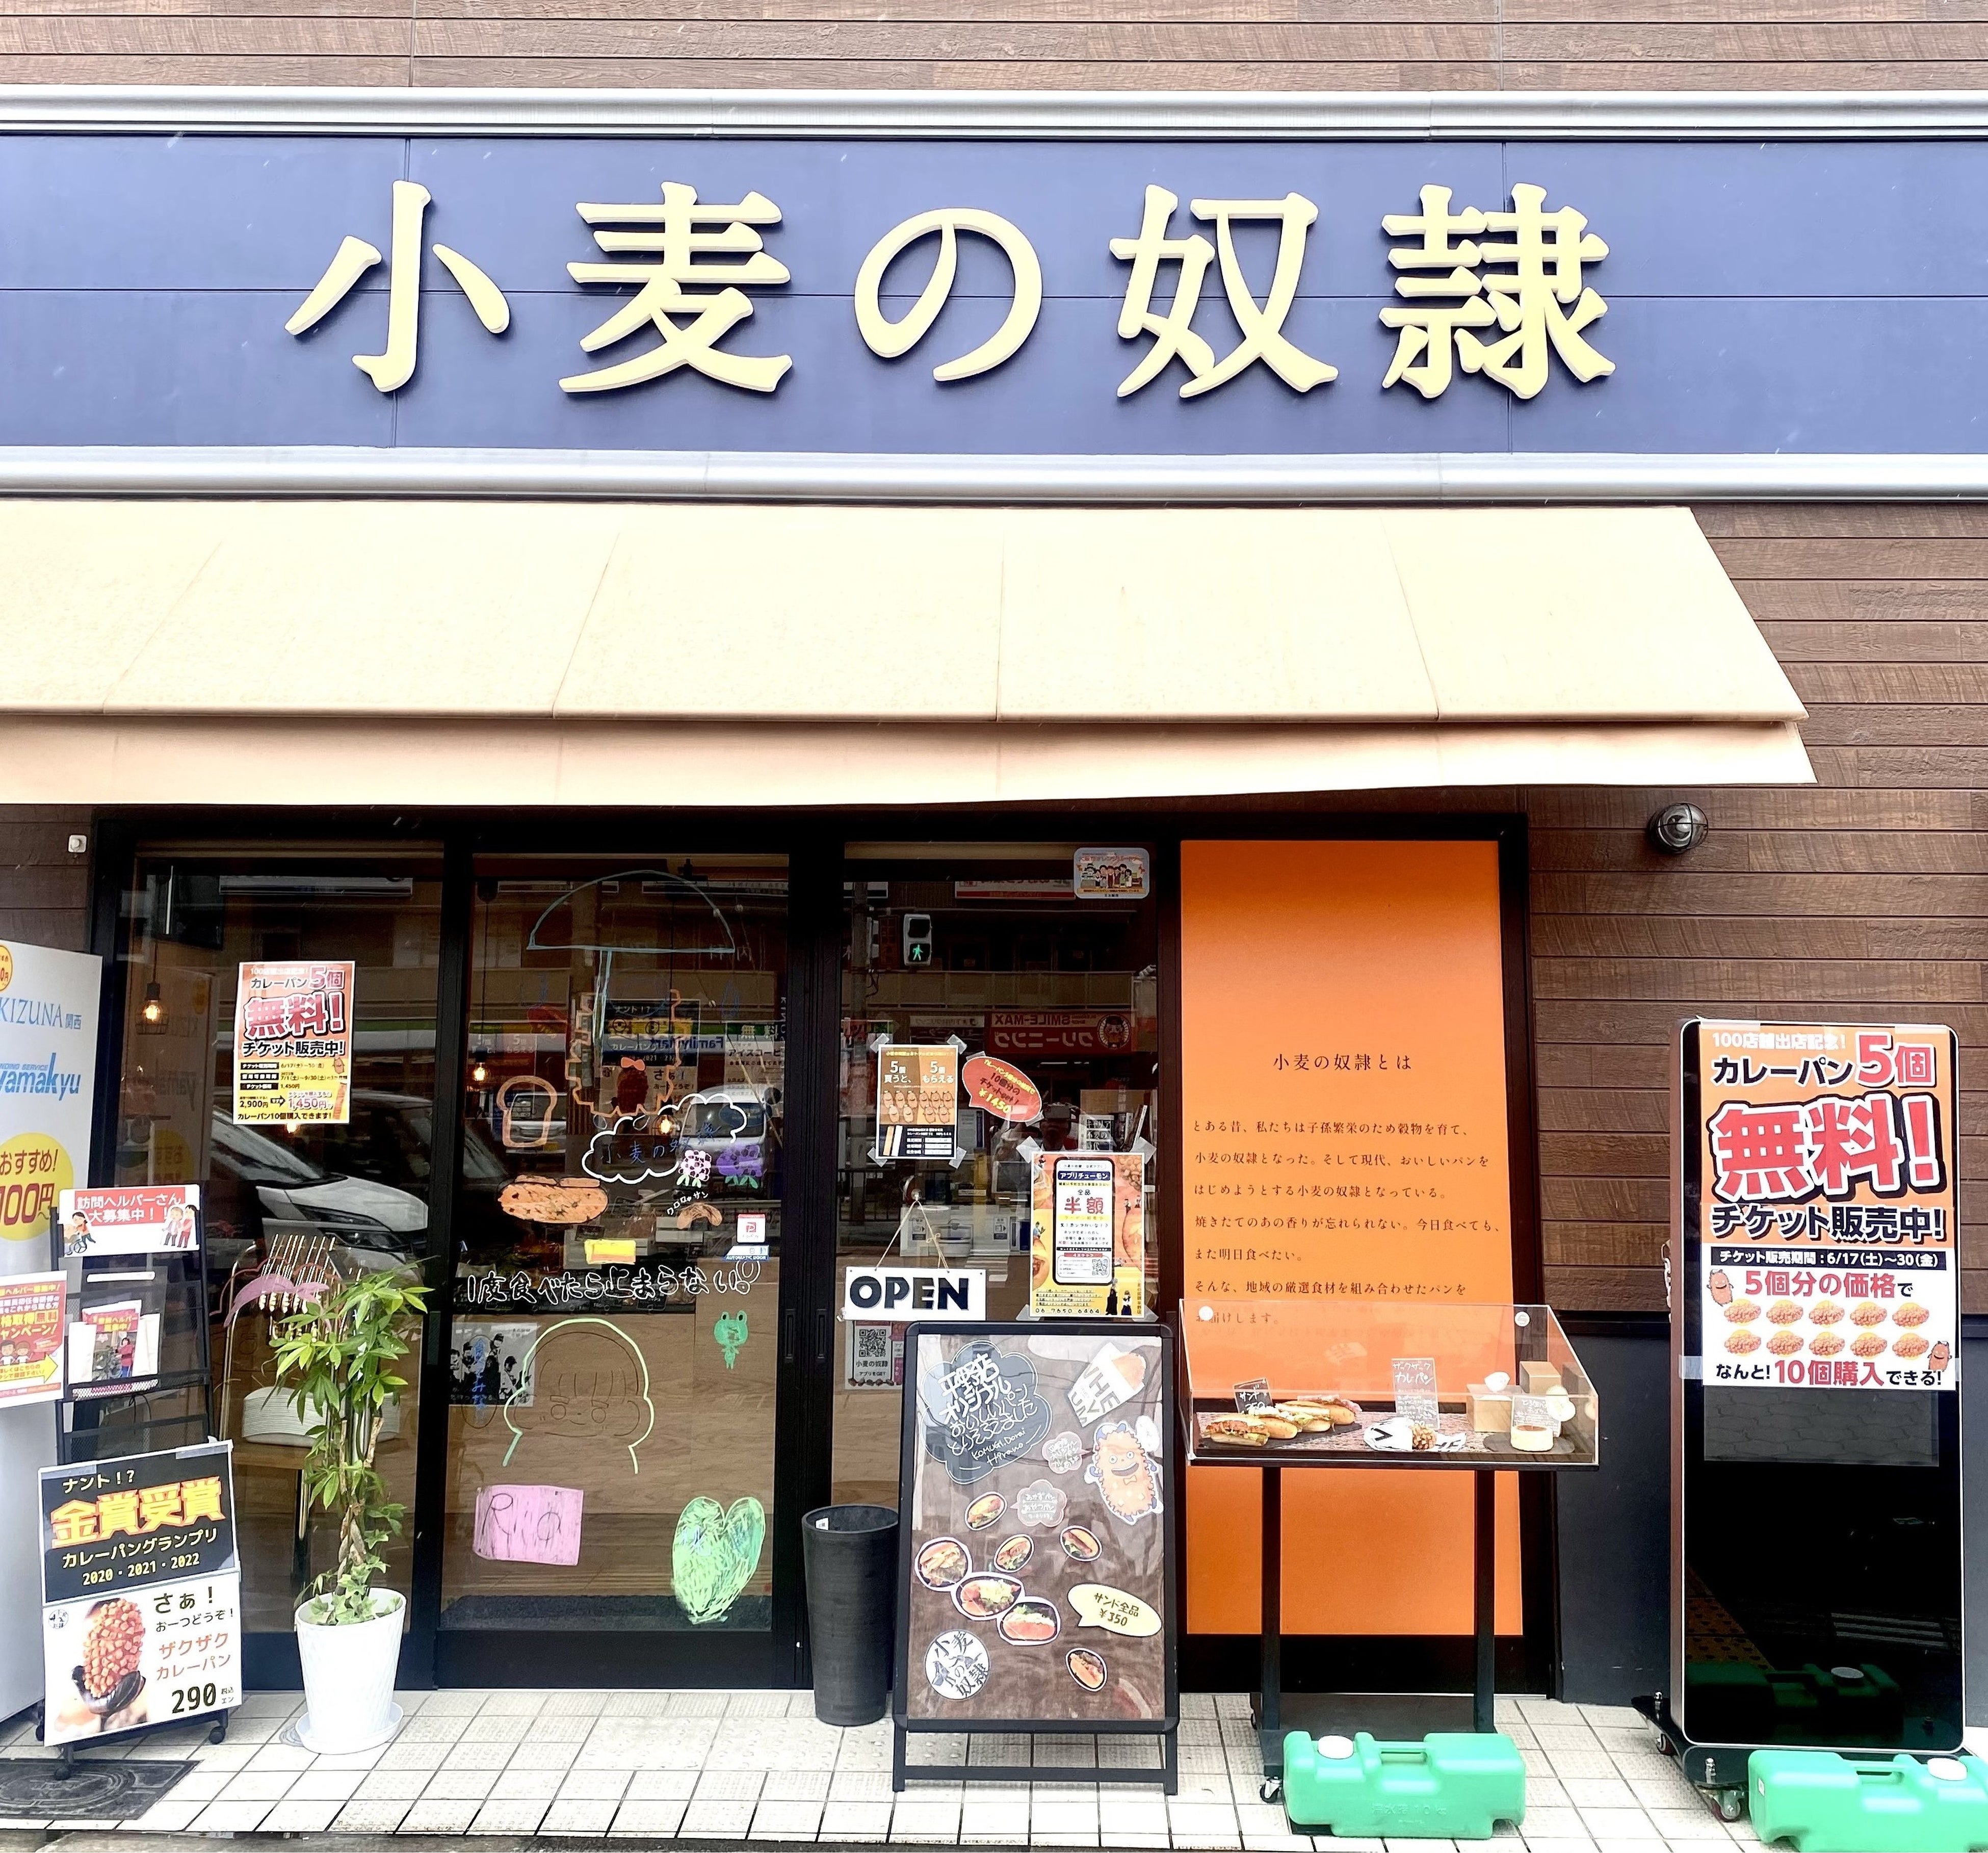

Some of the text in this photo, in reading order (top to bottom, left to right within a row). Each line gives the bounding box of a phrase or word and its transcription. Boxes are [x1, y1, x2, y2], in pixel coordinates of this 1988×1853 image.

[284, 180, 1616, 399] 小麦の奴隷
[251, 978, 307, 989] カレーパン
[309, 965, 344, 988] 5個
[247, 993, 342, 1037] 無料!
[243, 1040, 343, 1055] チケット販売中!
[1711, 1033, 1933, 1085] カレーパン 5個
[1273, 1053, 1412, 1071] 小麦の奴隷とは
[1193, 1120, 1469, 1136] とある昔、私たちは子孫繁栄のため穀物を育て、
[1194, 1152, 1489, 1167] 小麦の奴隷となった。そして現代、おいしいパンを
[1716, 1099, 1935, 1197] 無料!
[77, 1192, 181, 1209] 訪問ヘルパーさん
[1194, 1184, 1446, 1199] はじめようとする小麦の奴隷となっている。
[1064, 1196, 1104, 1215] 半額
[1195, 1215, 1501, 1232] 焼きたてのあの香りが忘れられない。今日食べても、
[1712, 1205, 1945, 1239] チケット販売中!
[1195, 1247, 1303, 1262] また明日食べたい。
[849, 1276, 969, 1311] OPEN
[1195, 1280, 1467, 1296] そんな、地域の厳選食材を組み合わせたパンを
[1745, 1270, 1913, 1298] 5個分の価格で
[51, 1476, 226, 1549] 金賞受賞
[62, 1528, 218, 1570] カレーパングランプリ
[1093, 1592, 1139, 1617] サンド全品
[159, 1632, 228, 1660] ザクザク
[156, 1654, 231, 1681] カレーパン
[171, 1683, 217, 1714] 290
